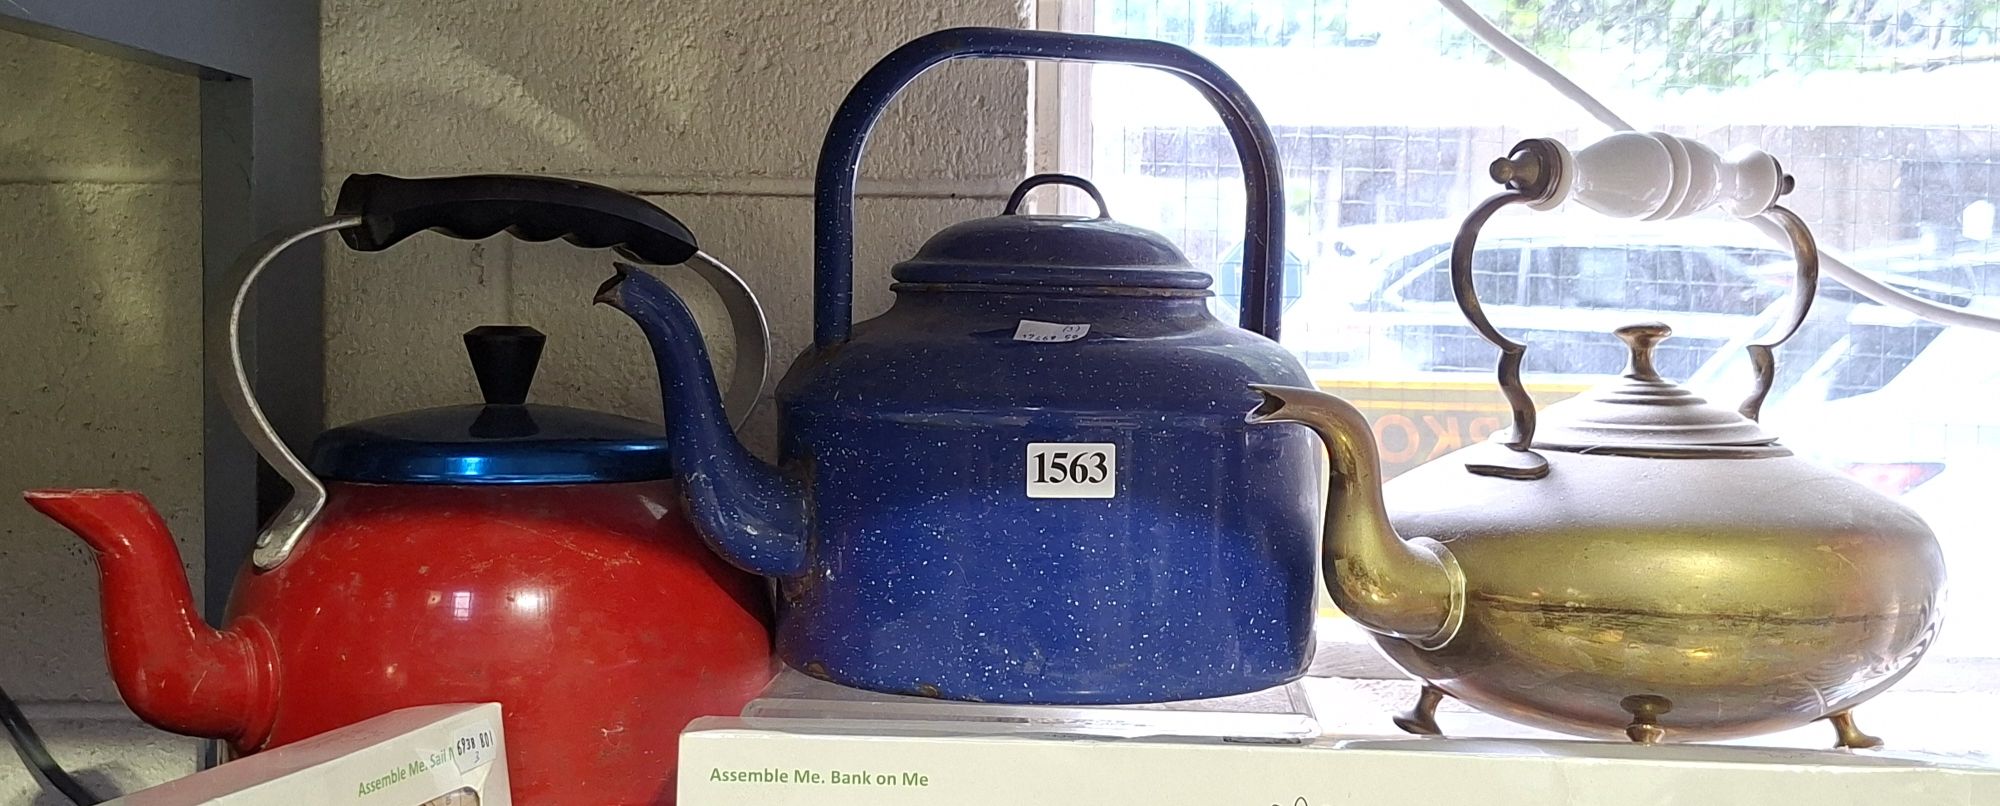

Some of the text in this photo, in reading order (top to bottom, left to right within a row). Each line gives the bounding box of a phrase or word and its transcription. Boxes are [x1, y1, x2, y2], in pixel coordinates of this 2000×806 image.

[1032, 451, 1109, 484] 1563
[358, 766, 407, 797] Assemble
[408, 760, 429, 777] Me.
[430, 748, 447, 769] Sail
[709, 767, 929, 787] Assemble Me. Bank on Me
